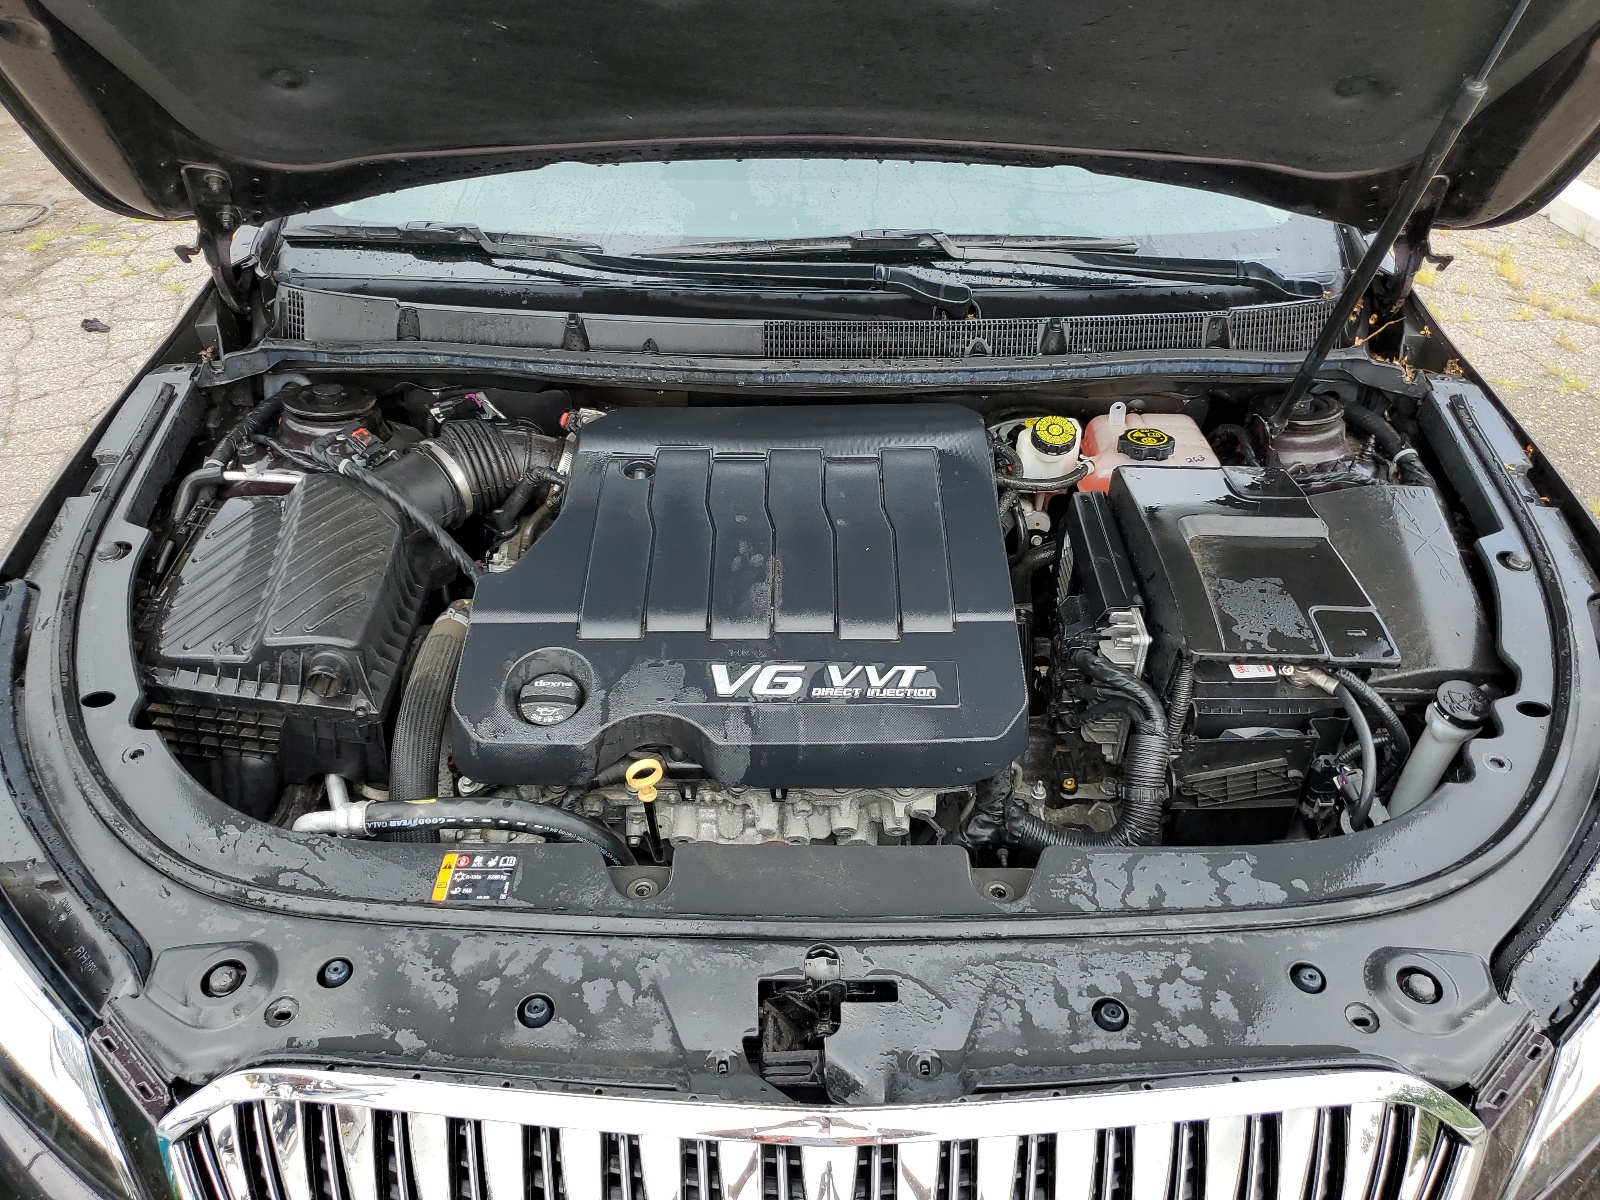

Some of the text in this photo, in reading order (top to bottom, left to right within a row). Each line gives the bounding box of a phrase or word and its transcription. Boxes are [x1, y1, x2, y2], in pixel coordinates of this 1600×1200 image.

[710, 664, 806, 697] V6
[826, 664, 927, 688] VVT
[812, 687, 937, 699] DIRECT INJECTION
[364, 817, 446, 828] GOODYEAR GALA
